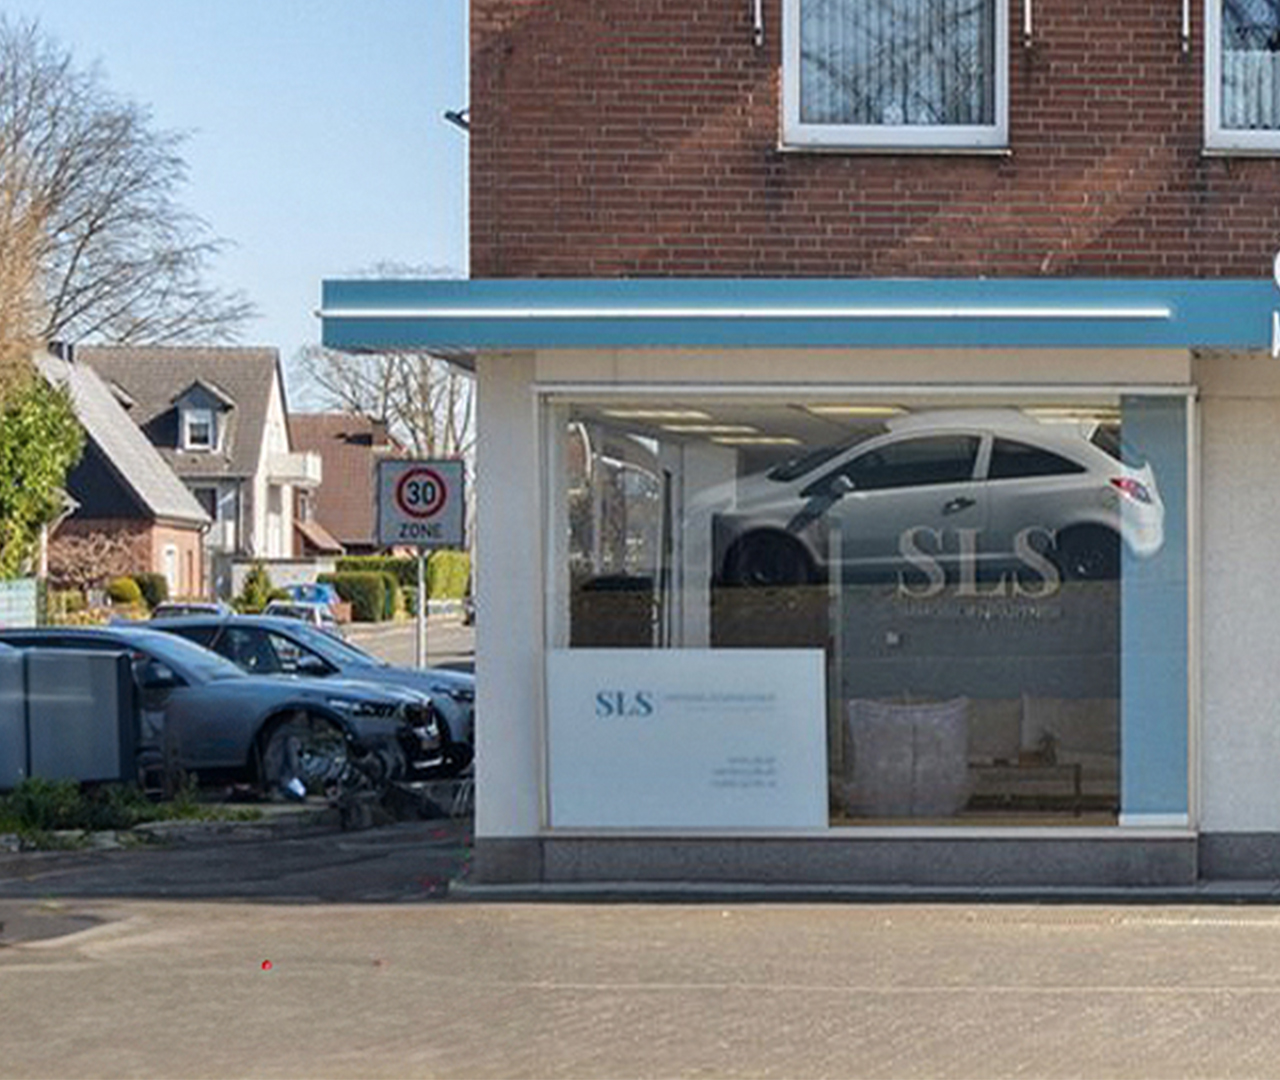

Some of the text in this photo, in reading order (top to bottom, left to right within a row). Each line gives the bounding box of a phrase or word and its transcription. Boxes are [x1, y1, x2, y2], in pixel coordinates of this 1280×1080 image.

[407, 481, 436, 506] 30
[400, 523, 442, 538] ZONE
[898, 525, 1060, 598] SLS
[595, 691, 654, 717] SLS
